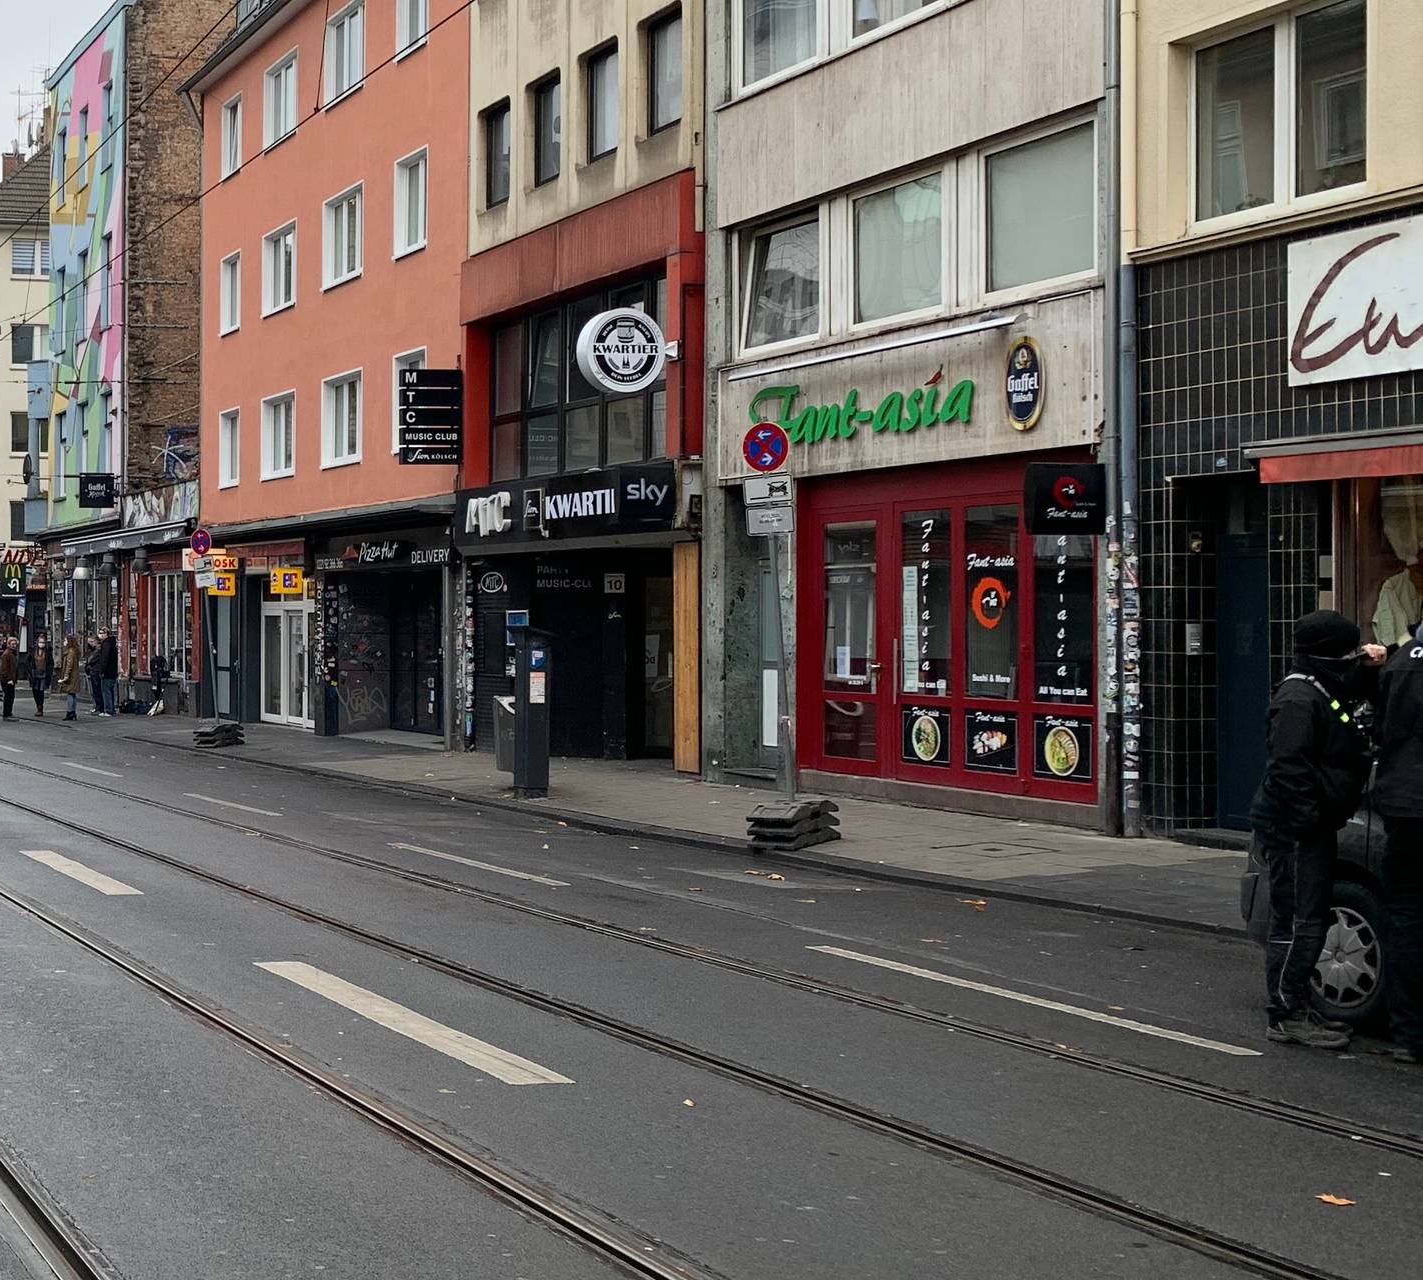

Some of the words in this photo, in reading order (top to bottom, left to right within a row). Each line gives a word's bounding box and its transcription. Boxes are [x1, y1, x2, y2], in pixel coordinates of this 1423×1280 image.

[593, 344, 659, 354] KWARTIER
[405, 371, 417, 384] M
[1007, 371, 1039, 393] Gaffel
[406, 391, 416, 403] T
[405, 411, 416, 423] C
[626, 477, 668, 506] sky
[1046, 507, 1089, 519] Fant-asia
[358, 542, 380, 564] Pizza
[381, 540, 399, 560] Hut
[411, 548, 450, 564] DELIVERY
[214, 558, 236, 568] OSK
[966, 553, 1015, 571] Fant-asia
[217, 577, 231, 591] EC
[283, 572, 298, 588] EC
[607, 580, 623, 590] 10
[532, 650, 544, 666] P
[972, 673, 989, 683] Sushi
[989, 674, 995, 682] &
[995, 674, 1011, 683] More
[1039, 686, 1048, 694] All
[1049, 687, 1062, 695] You
[1076, 688, 1088, 696] Eat
